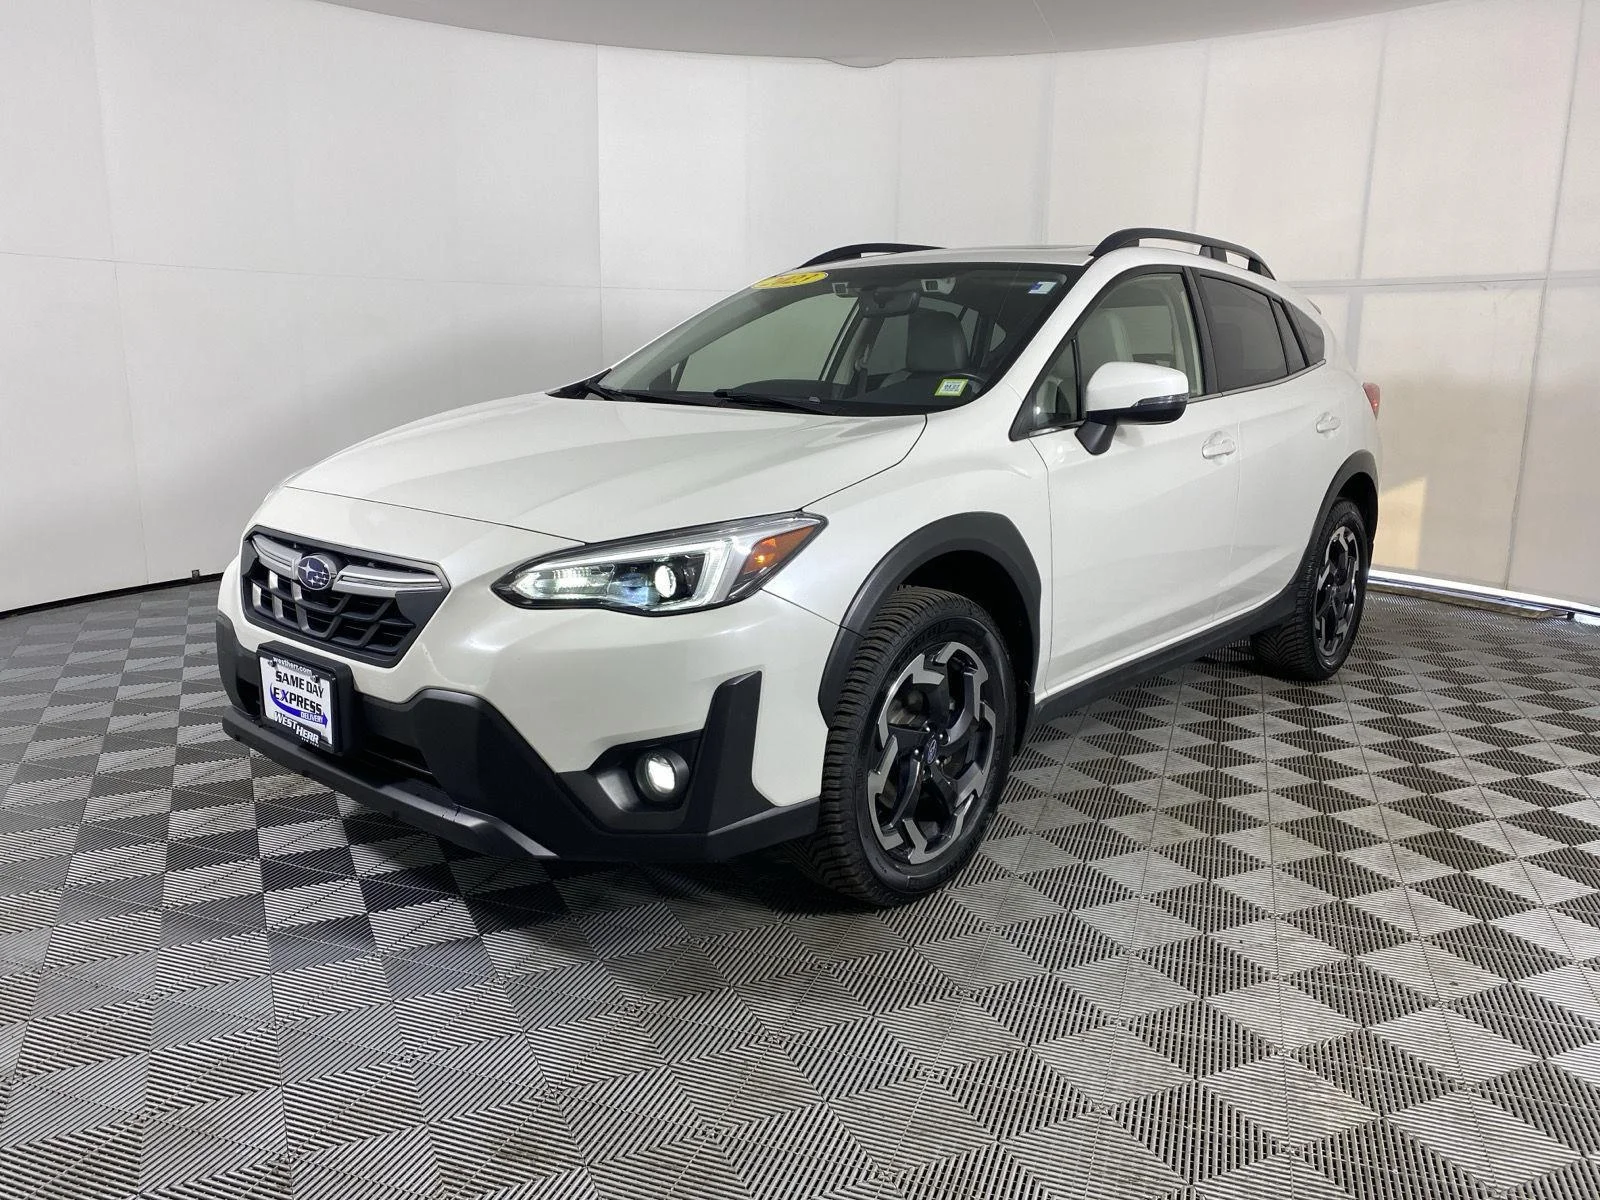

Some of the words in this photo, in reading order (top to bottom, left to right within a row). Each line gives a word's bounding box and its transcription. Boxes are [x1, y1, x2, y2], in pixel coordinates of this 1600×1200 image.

[275, 670, 305, 690] SAME
[306, 680, 324, 698] DAY
[273, 687, 322, 715] EXPRESS
[300, 711, 323, 724] DELIVERY
